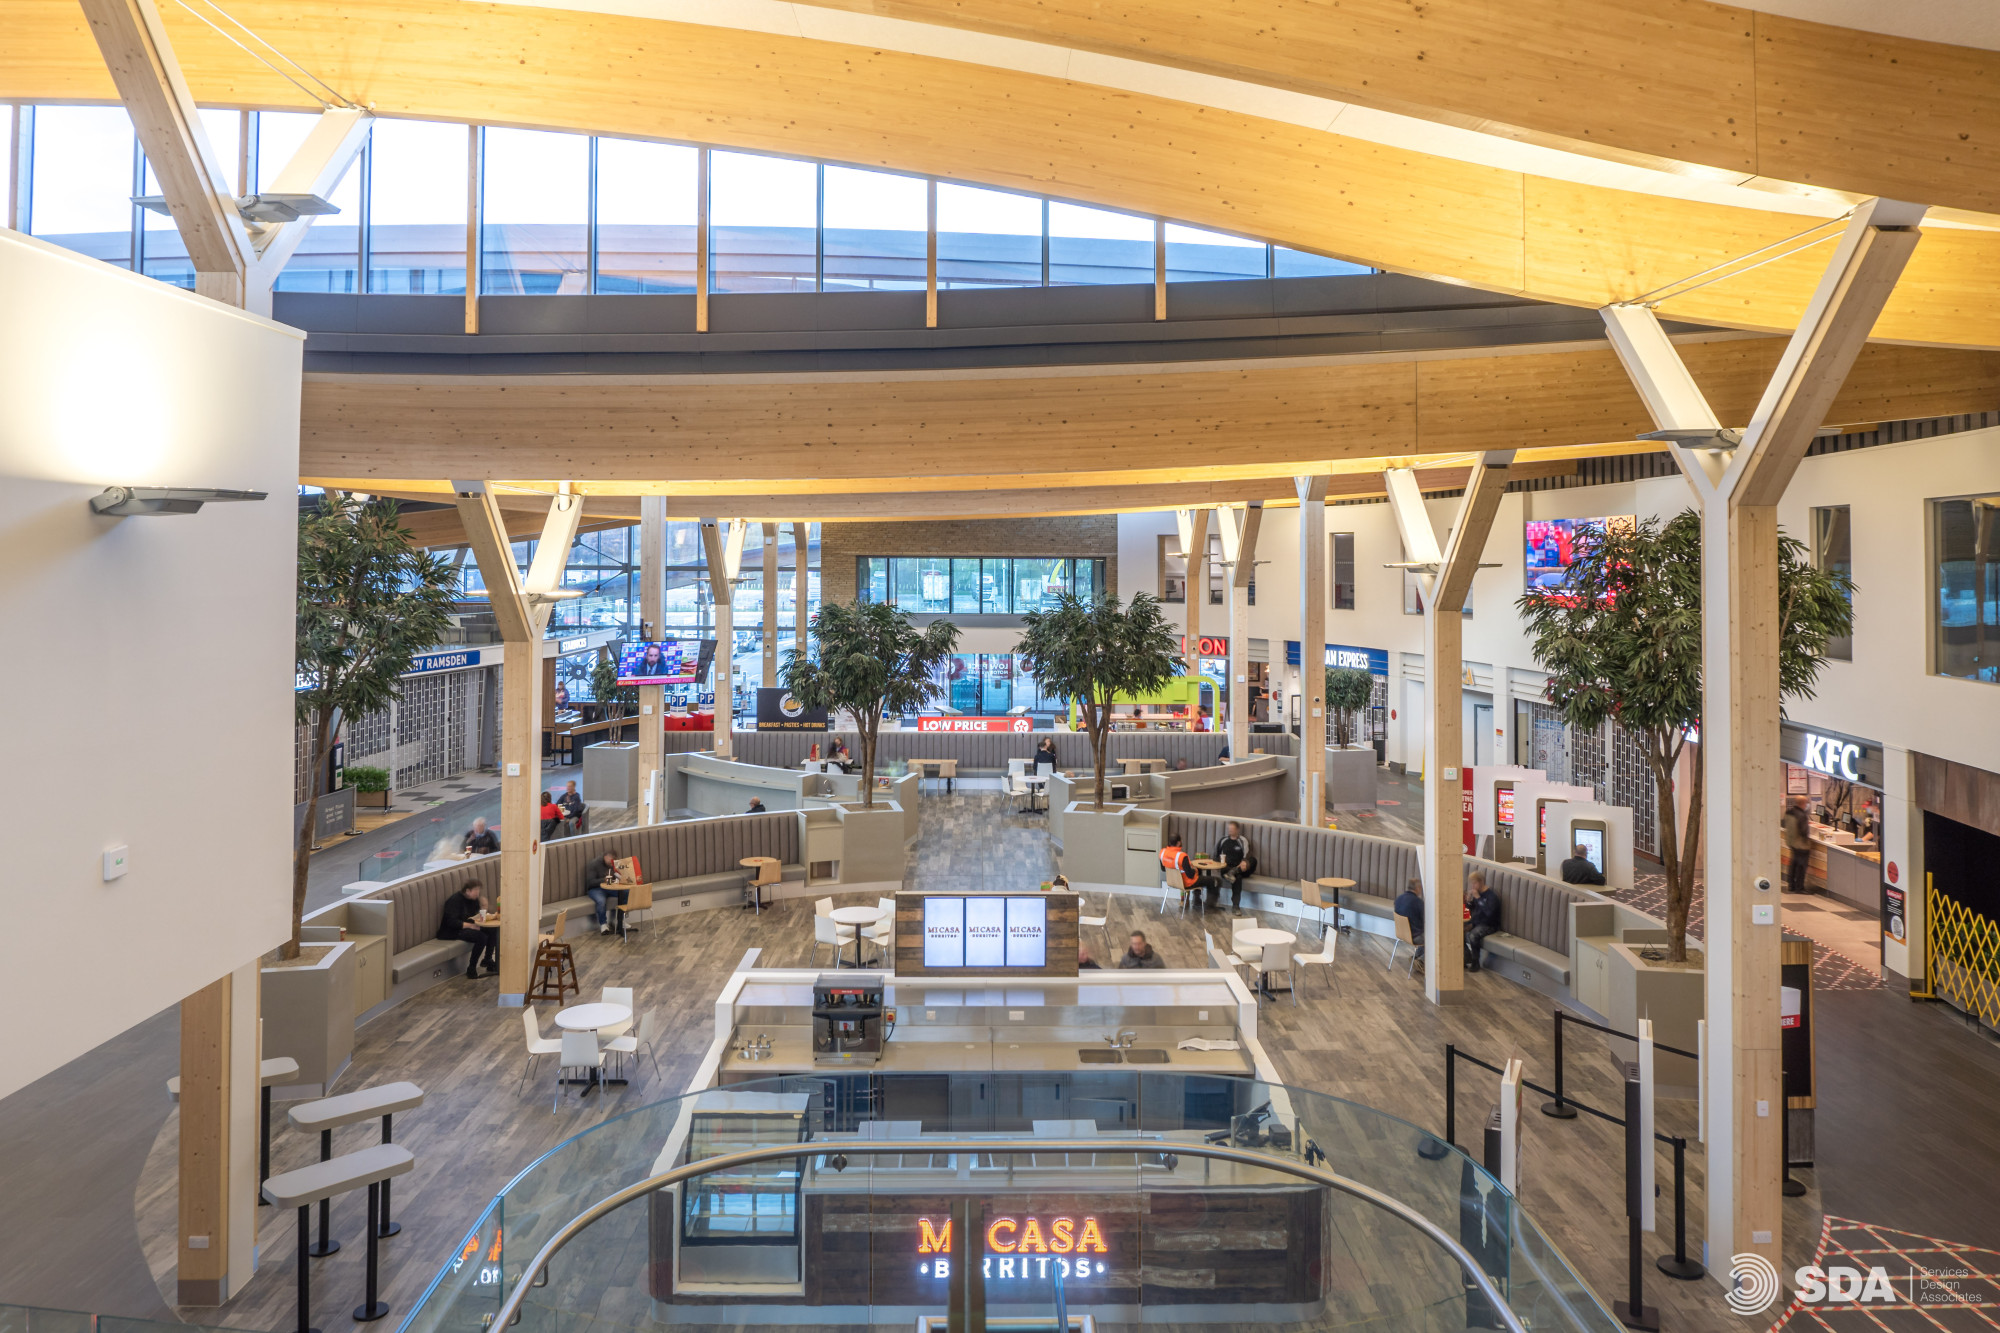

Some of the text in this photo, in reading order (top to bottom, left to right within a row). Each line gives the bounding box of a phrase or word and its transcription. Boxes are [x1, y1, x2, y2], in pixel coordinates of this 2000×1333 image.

[426, 654, 467, 669] RAMSDEN
[1338, 651, 1368, 669] EXPRESS
[679, 696, 686, 706] P
[923, 720, 988, 731] LOW PRICE
[1803, 733, 1860, 781] KFC
[918, 1217, 1108, 1253] M CASA
